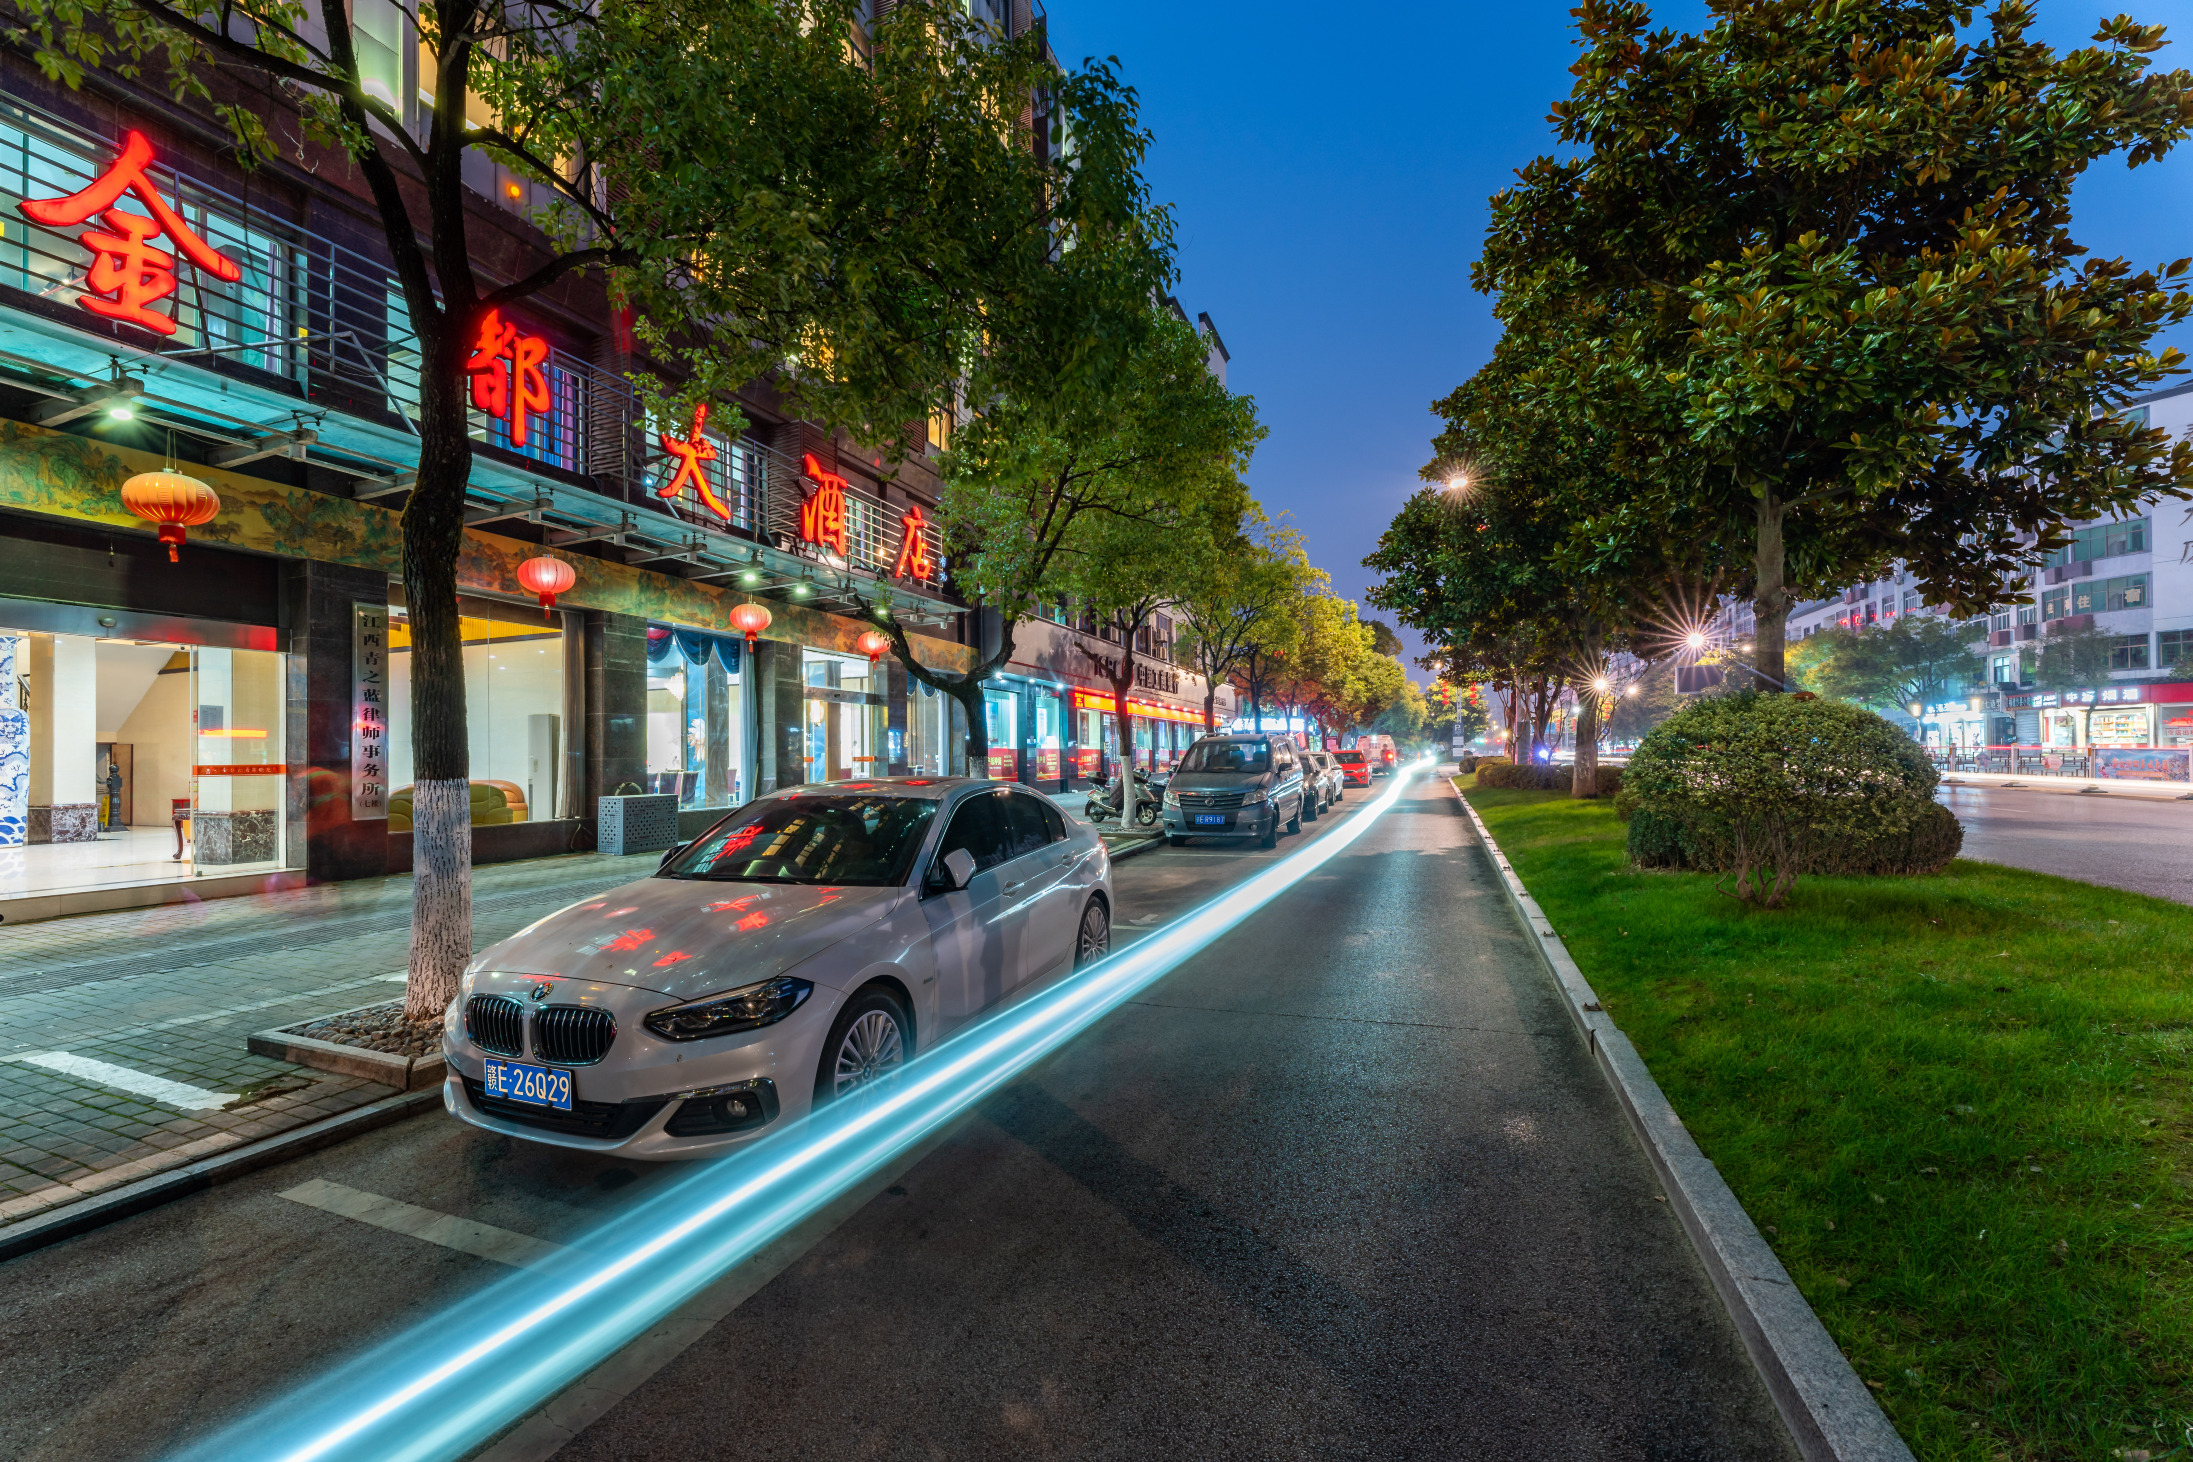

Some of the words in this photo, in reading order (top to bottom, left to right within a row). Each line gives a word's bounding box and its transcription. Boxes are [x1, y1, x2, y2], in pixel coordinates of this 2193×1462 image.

[2077, 588, 2141, 610] 住宿
[362, 614, 381, 796] 江西青之蓝律师事务所
